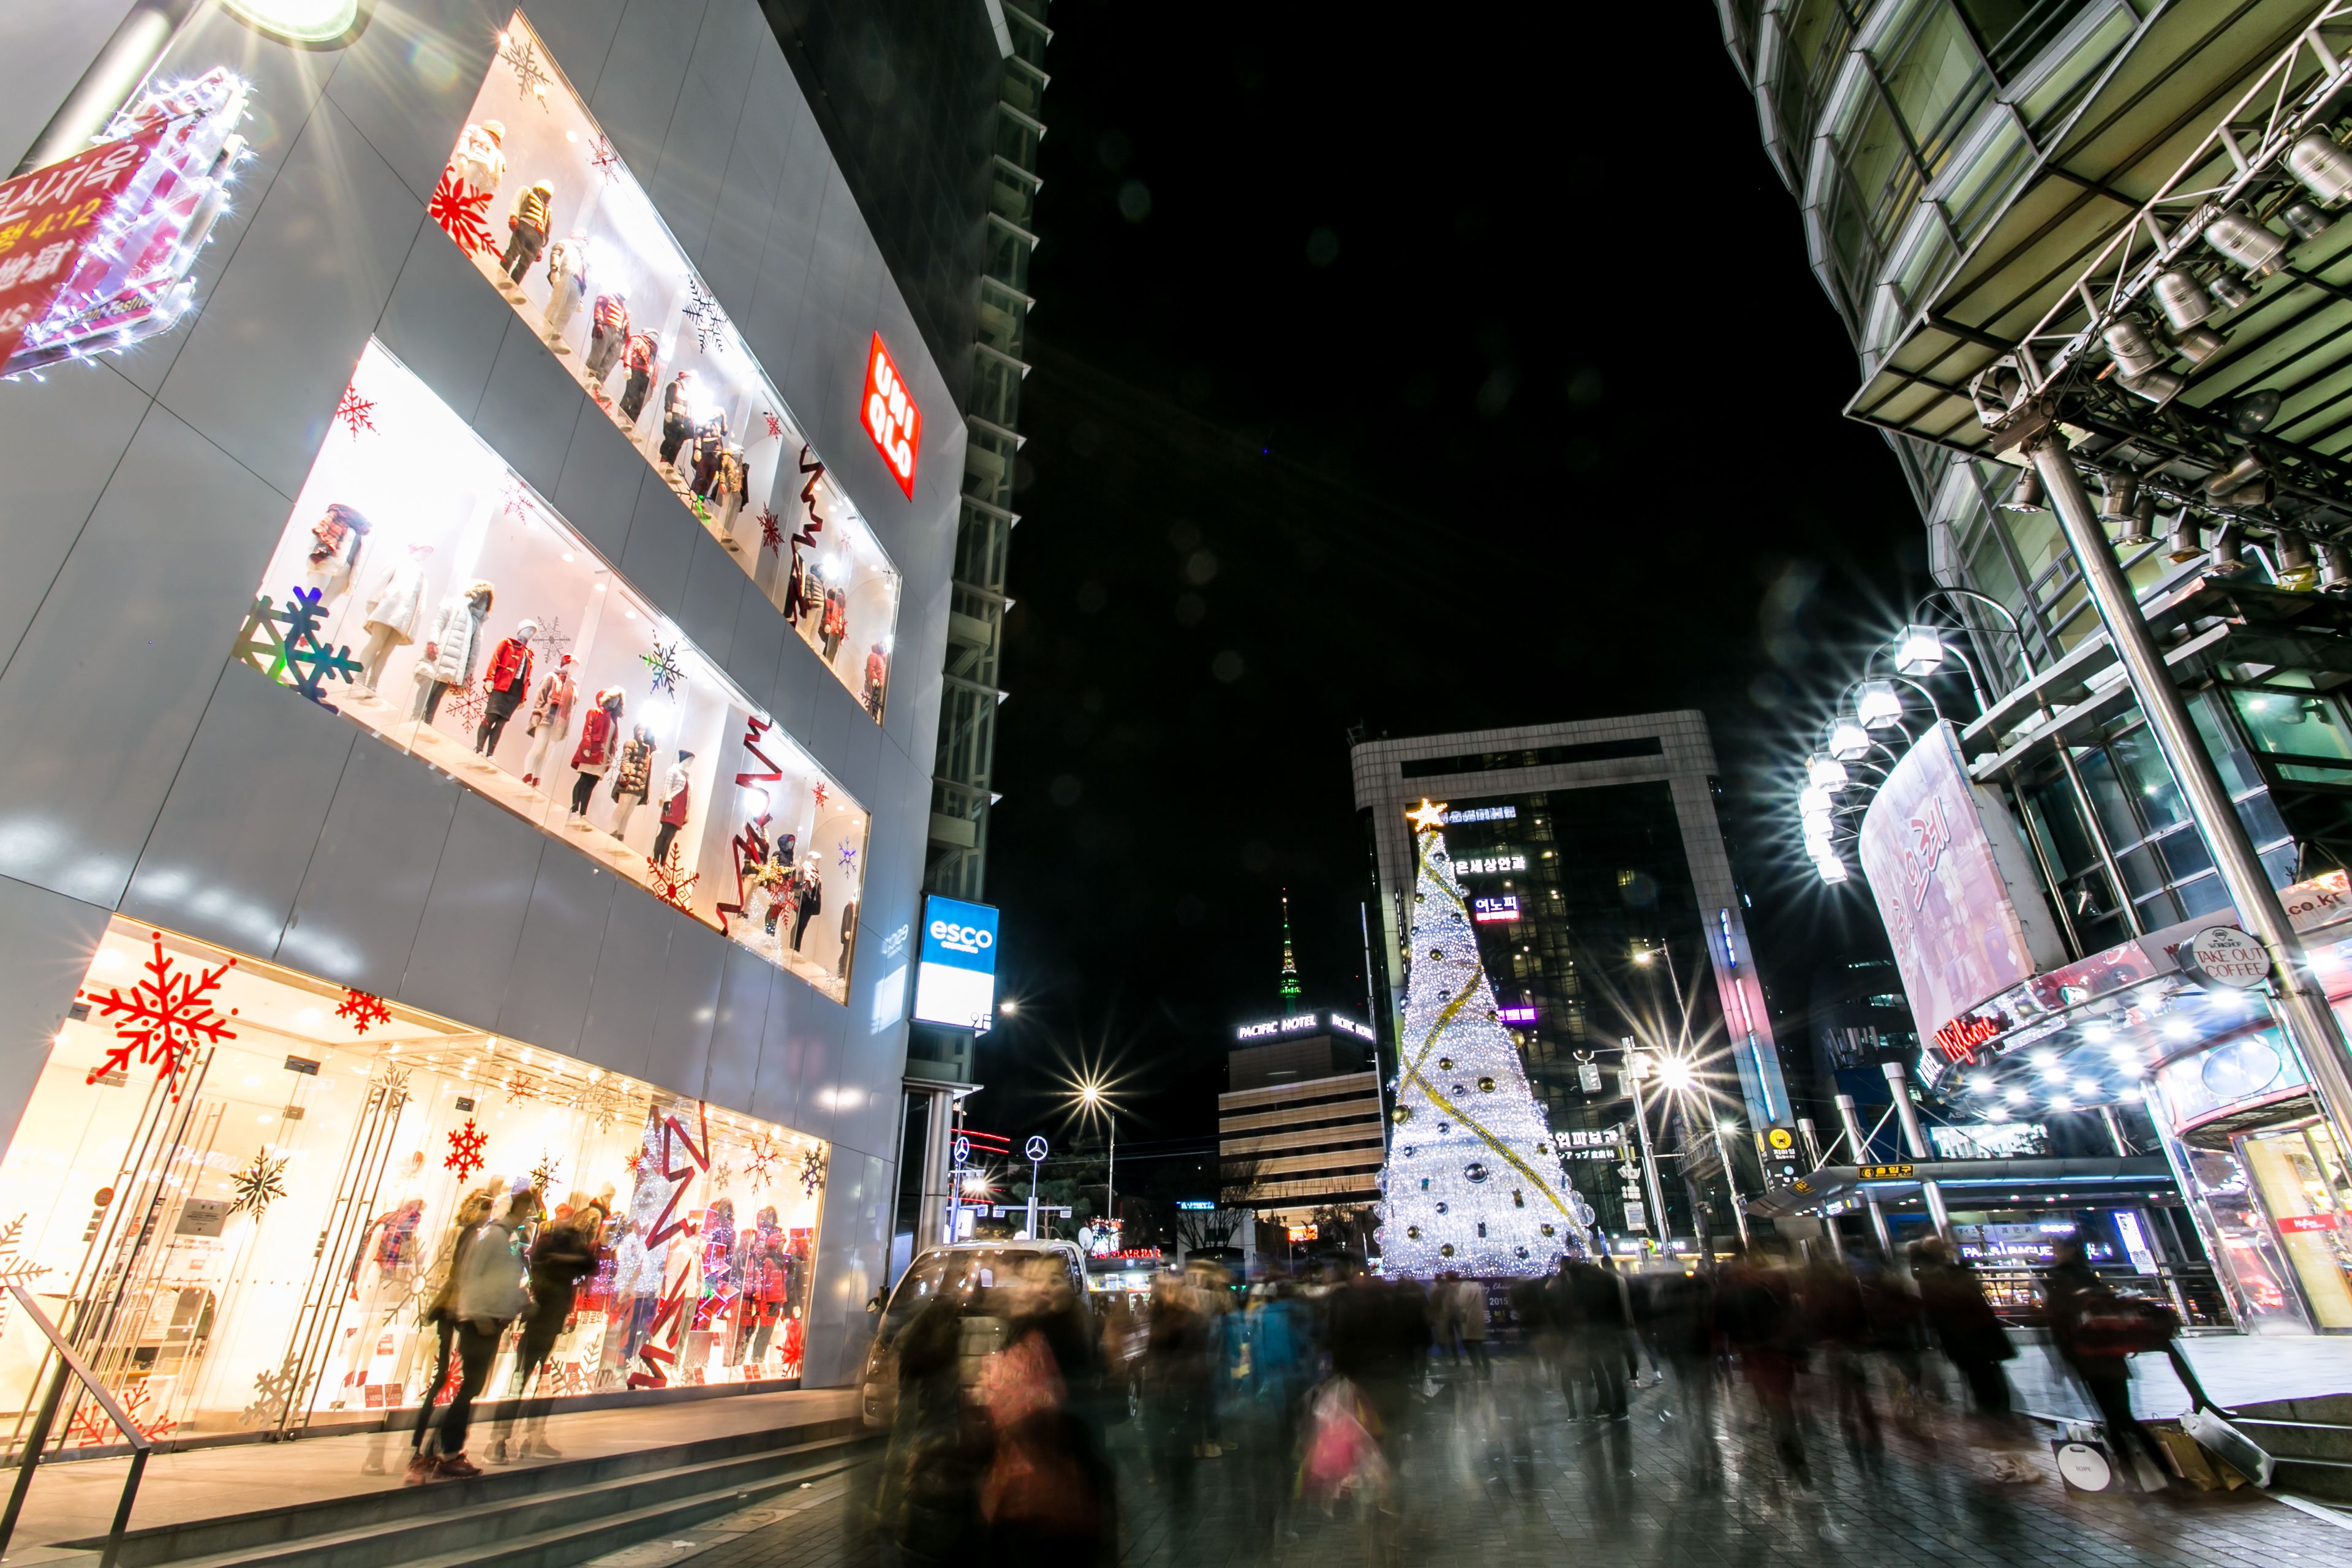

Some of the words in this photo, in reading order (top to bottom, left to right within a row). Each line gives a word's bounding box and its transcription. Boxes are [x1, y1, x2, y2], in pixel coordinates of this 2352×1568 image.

[29, 197, 103, 239] 4:12
[107, 292, 163, 315] Festiv
[875, 352, 913, 440] UNI
[869, 393, 913, 478] QLO
[1476, 895, 1518, 913] 여노피
[930, 920, 993, 949] esco
[2193, 949, 2230, 963] TAKE
[2231, 947, 2263, 962] OUT
[2205, 962, 2266, 978] COFFEE
[970, 1012, 992, 1030] 9F
[1238, 1021, 1278, 1039] PACIFIC
[1281, 1014, 1316, 1032] HOTEL
[1548, 1130, 1619, 1148] 업피부과
[1510, 1155, 1528, 1172] Light
[1958, 1226, 1990, 1235] ダイエト
[1962, 1246, 2001, 1257] PAS
[1489, 1297, 1509, 1306] 2015
